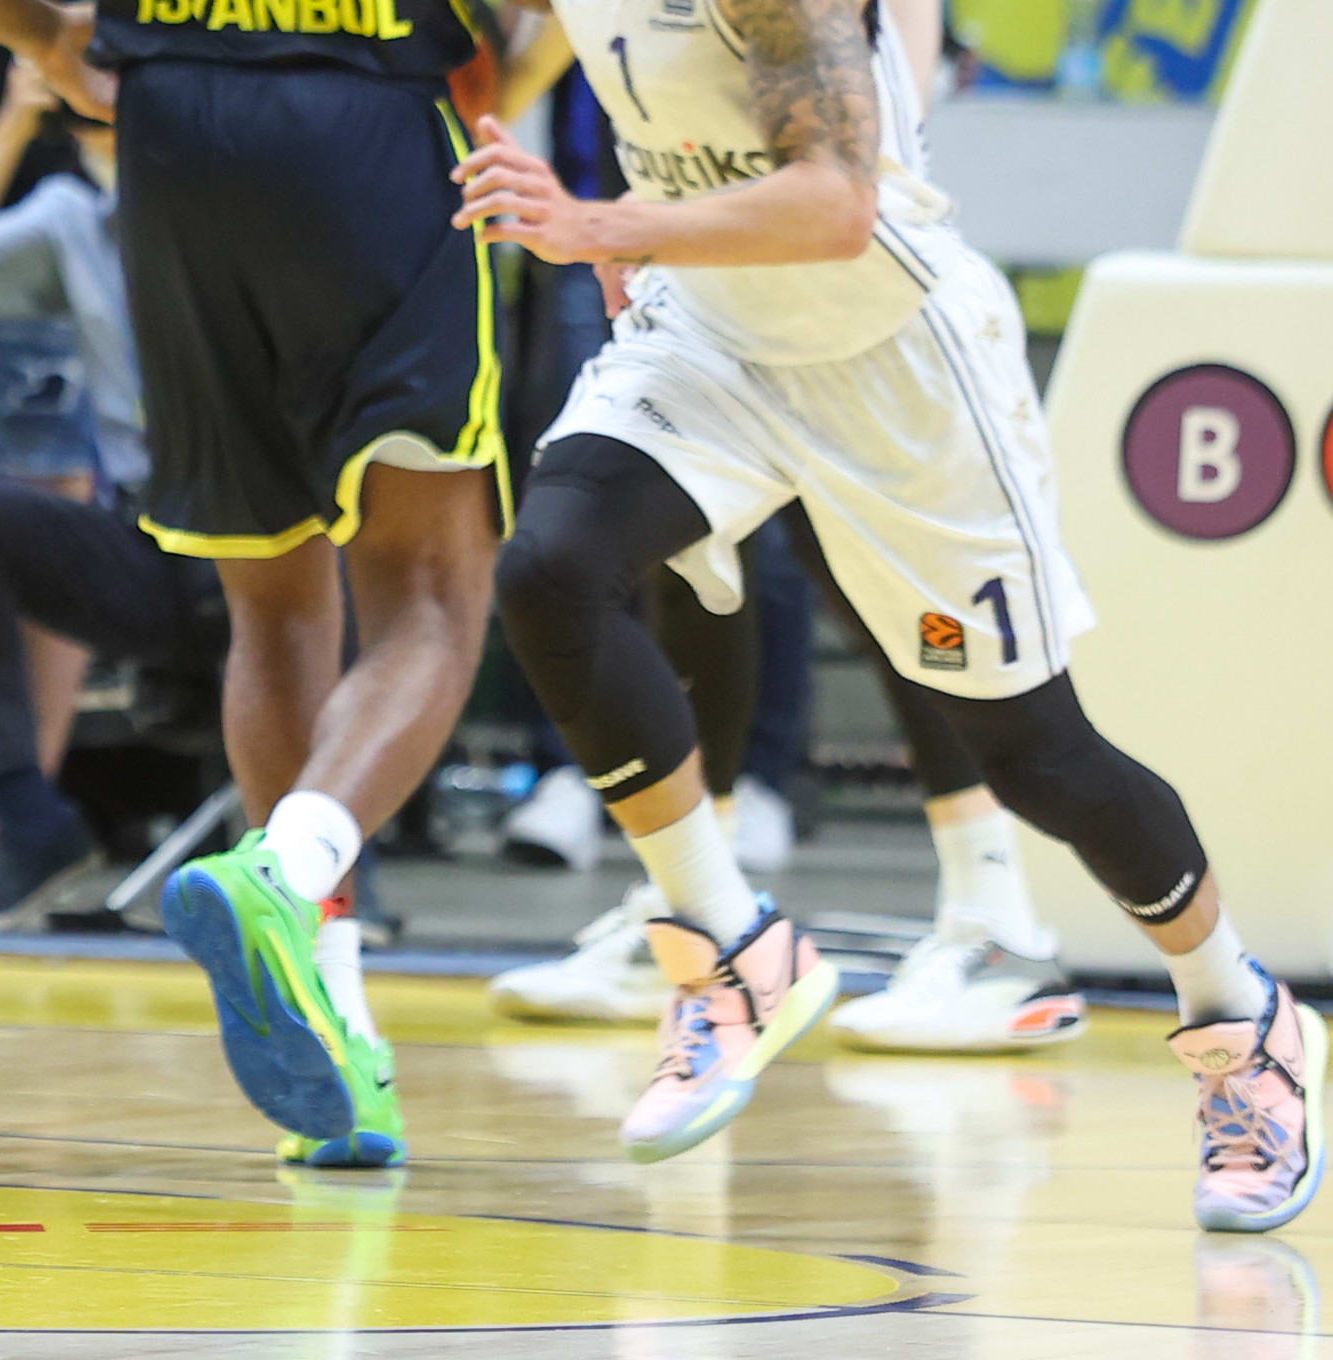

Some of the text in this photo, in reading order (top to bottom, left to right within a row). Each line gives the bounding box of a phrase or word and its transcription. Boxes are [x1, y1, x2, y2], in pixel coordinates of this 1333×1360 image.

[609, 36, 651, 123] 1
[1176, 406, 1243, 503] B
[971, 577, 1019, 665] 1
